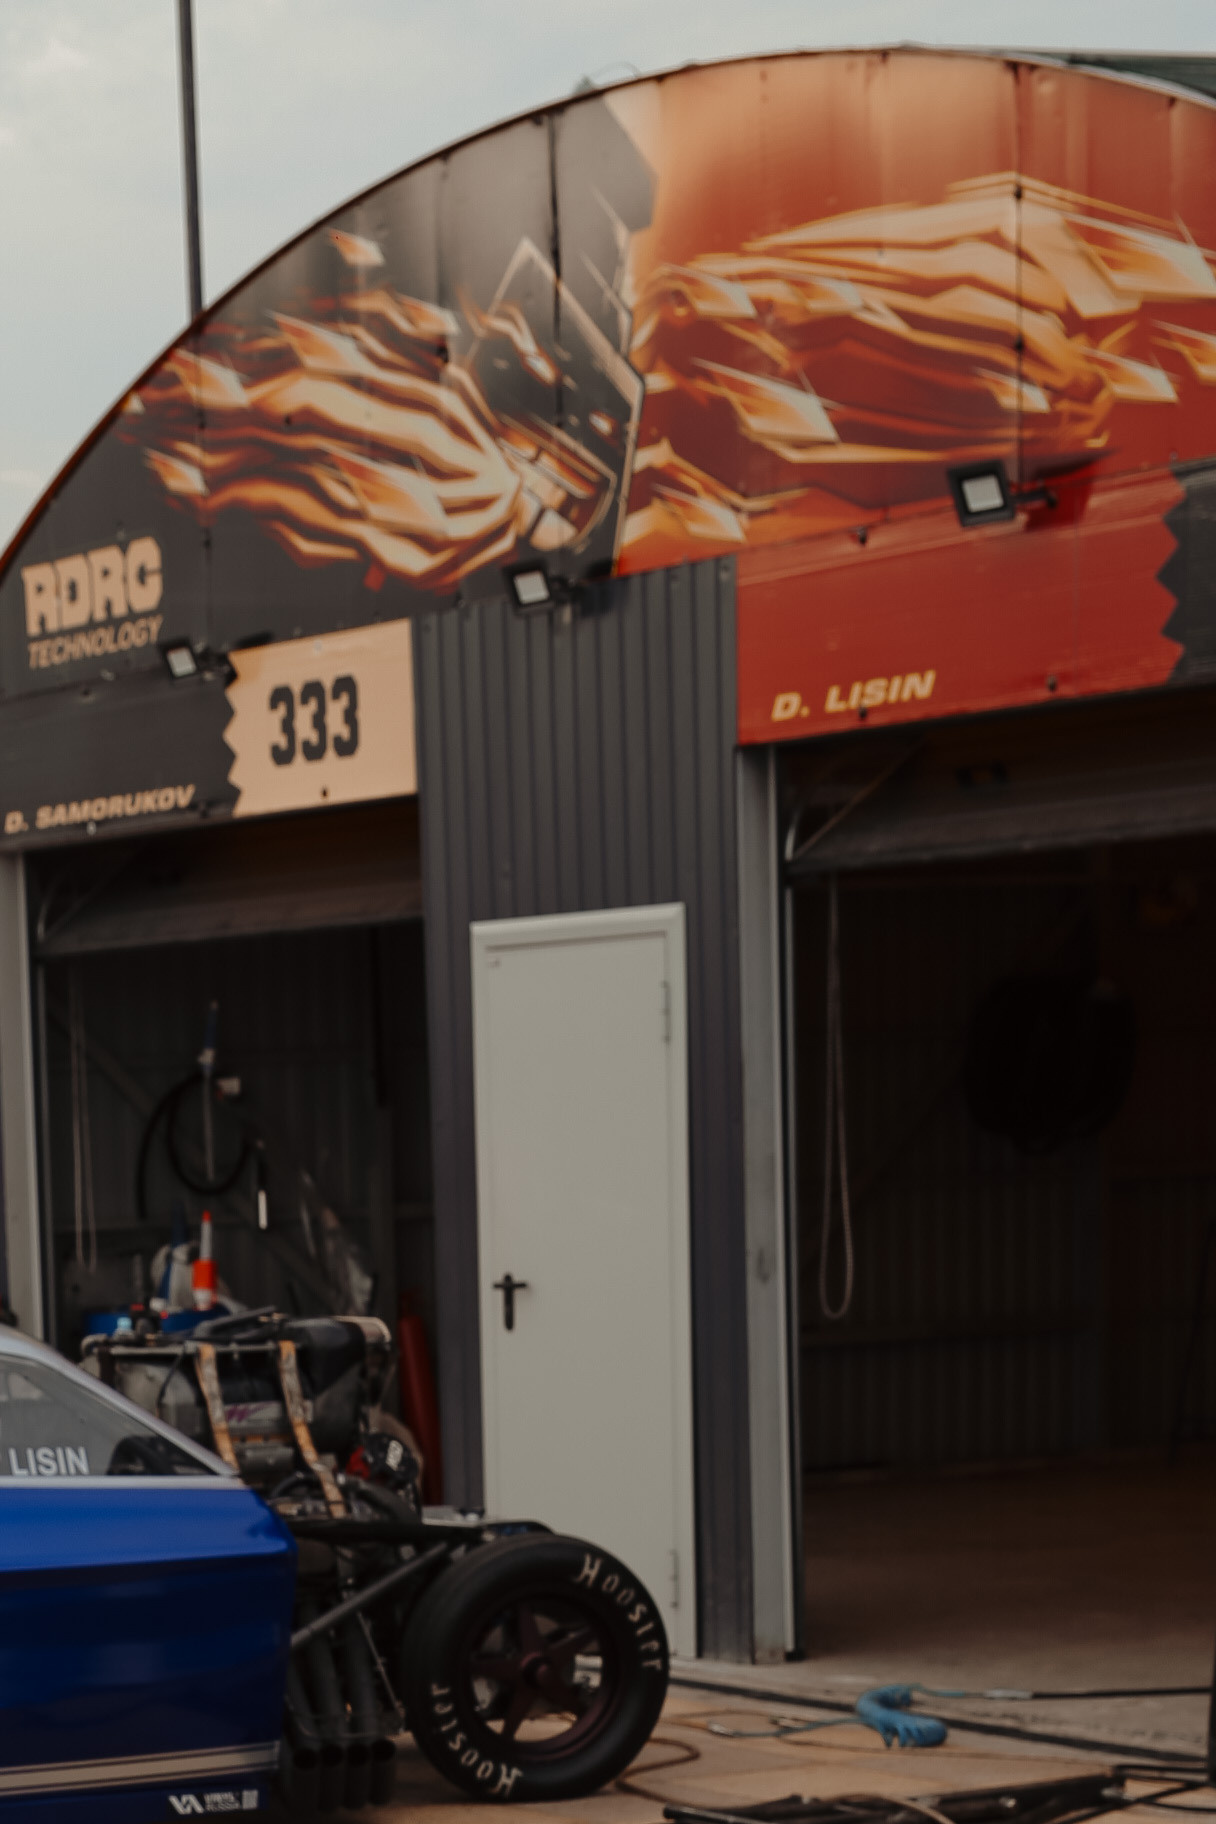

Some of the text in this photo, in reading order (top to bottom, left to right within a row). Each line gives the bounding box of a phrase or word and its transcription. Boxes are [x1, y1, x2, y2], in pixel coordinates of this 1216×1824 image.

[22, 536, 163, 637] RDRC
[28, 615, 163, 669] TECHNOLOGY
[269, 675, 360, 766] 333
[771, 670, 936, 722] D. LISIN
[4, 785, 195, 834] D. SAMORUKOV
[10, 1447, 89, 1476] LISIN
